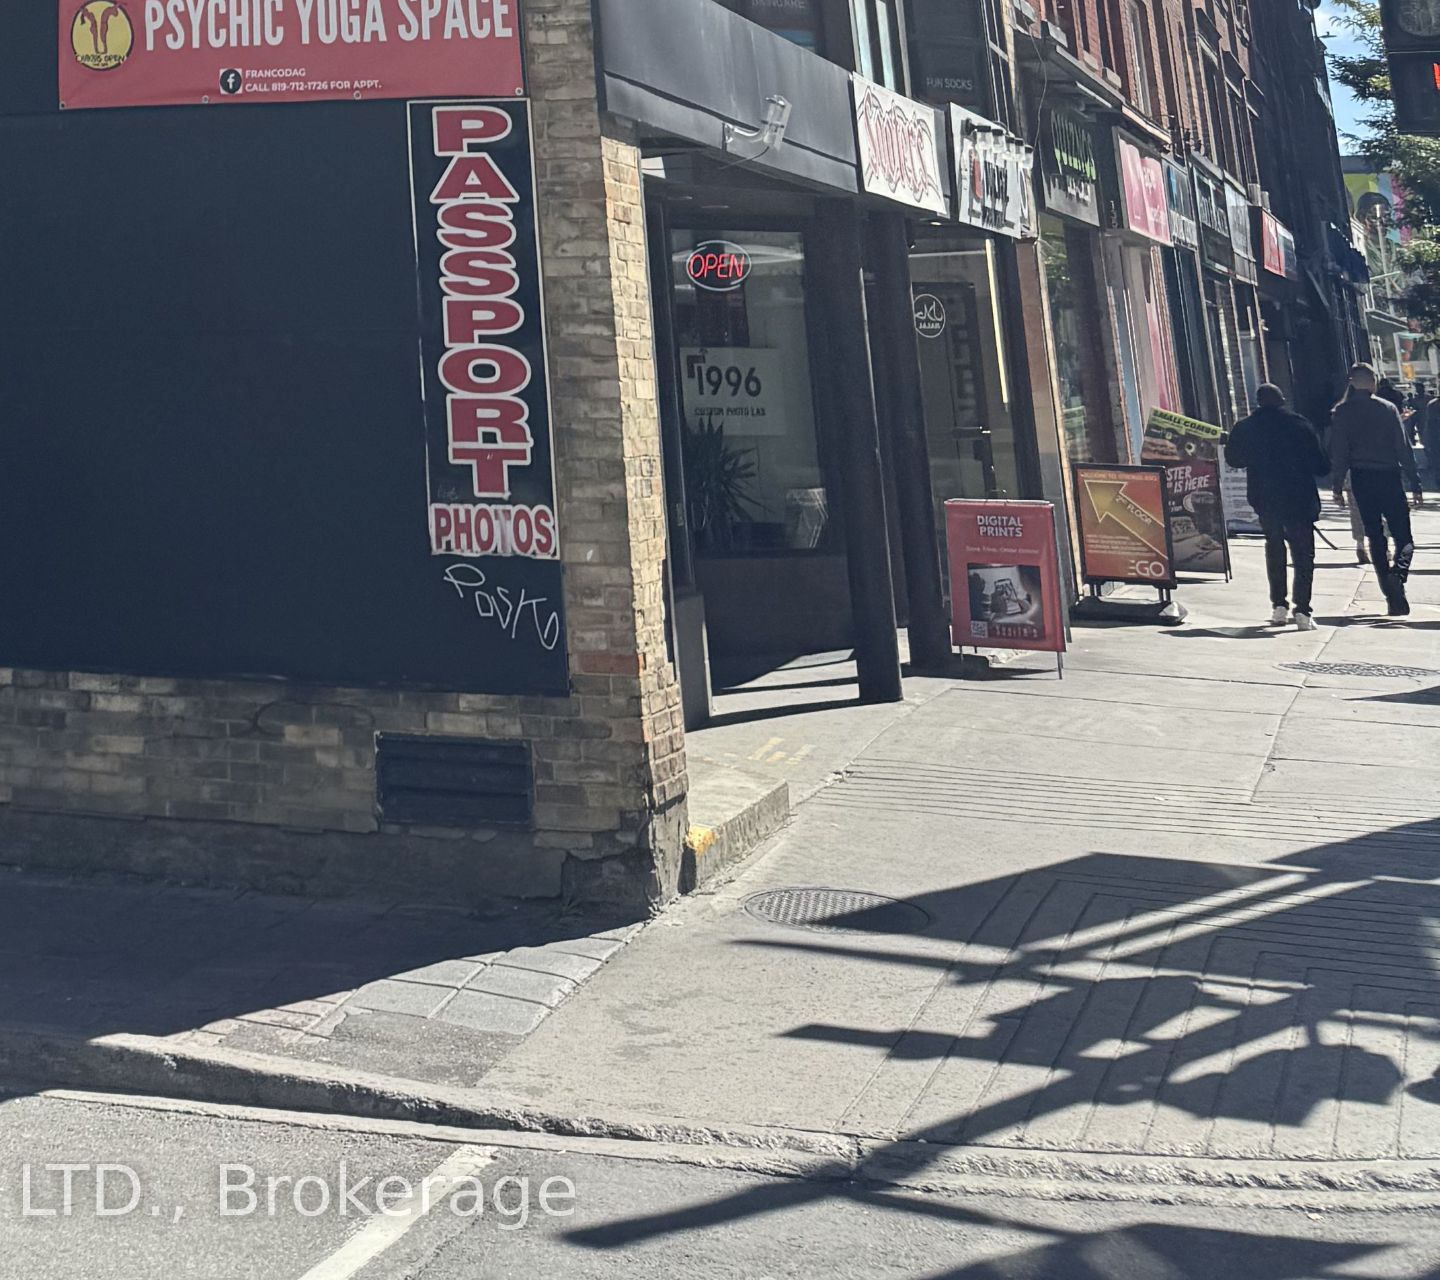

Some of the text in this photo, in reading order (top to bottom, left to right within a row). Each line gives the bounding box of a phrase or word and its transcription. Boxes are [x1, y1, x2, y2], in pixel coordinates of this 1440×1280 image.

[245, 82, 270, 92] CALL
[330, 80, 351, 90] FOR
[945, 78, 973, 90] SOCKS
[689, 253, 745, 278] OPEN
[430, 106, 533, 498] PASSPORT
[696, 366, 762, 397] 1996
[726, 406, 750, 417] PHOTO
[1183, 420, 1218, 436] COMBO
[1173, 481, 1183, 494] IS
[1184, 474, 1210, 492] HERE
[976, 515, 1023, 527] DIGITAL
[1127, 503, 1153, 525] FLOOR
[431, 504, 556, 555] PHOTOS
[979, 526, 1023, 537] PRINTS
[1127, 559, 1165, 577] EGO
